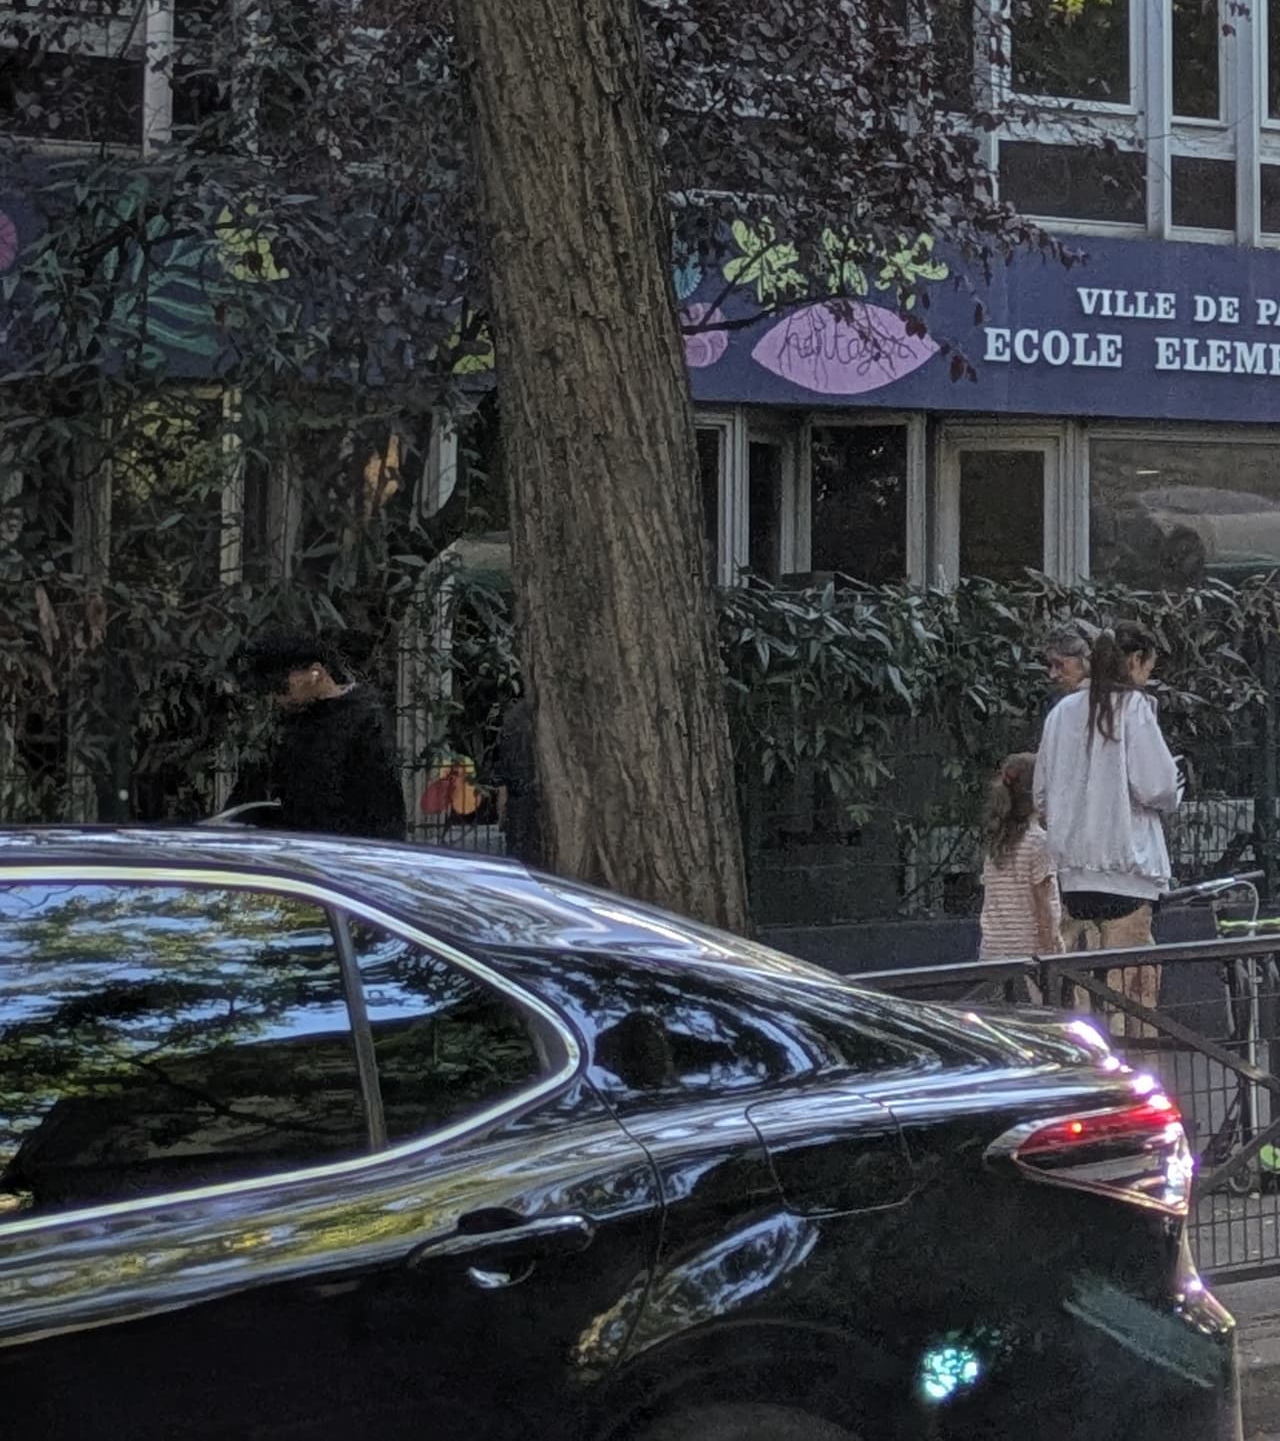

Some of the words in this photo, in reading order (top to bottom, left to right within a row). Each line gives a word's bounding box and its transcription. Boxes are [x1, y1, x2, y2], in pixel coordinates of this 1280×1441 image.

[1076, 286, 1177, 321] VILLE
[1193, 294, 1240, 324] DE
[983, 326, 1123, 369] ECOLE
